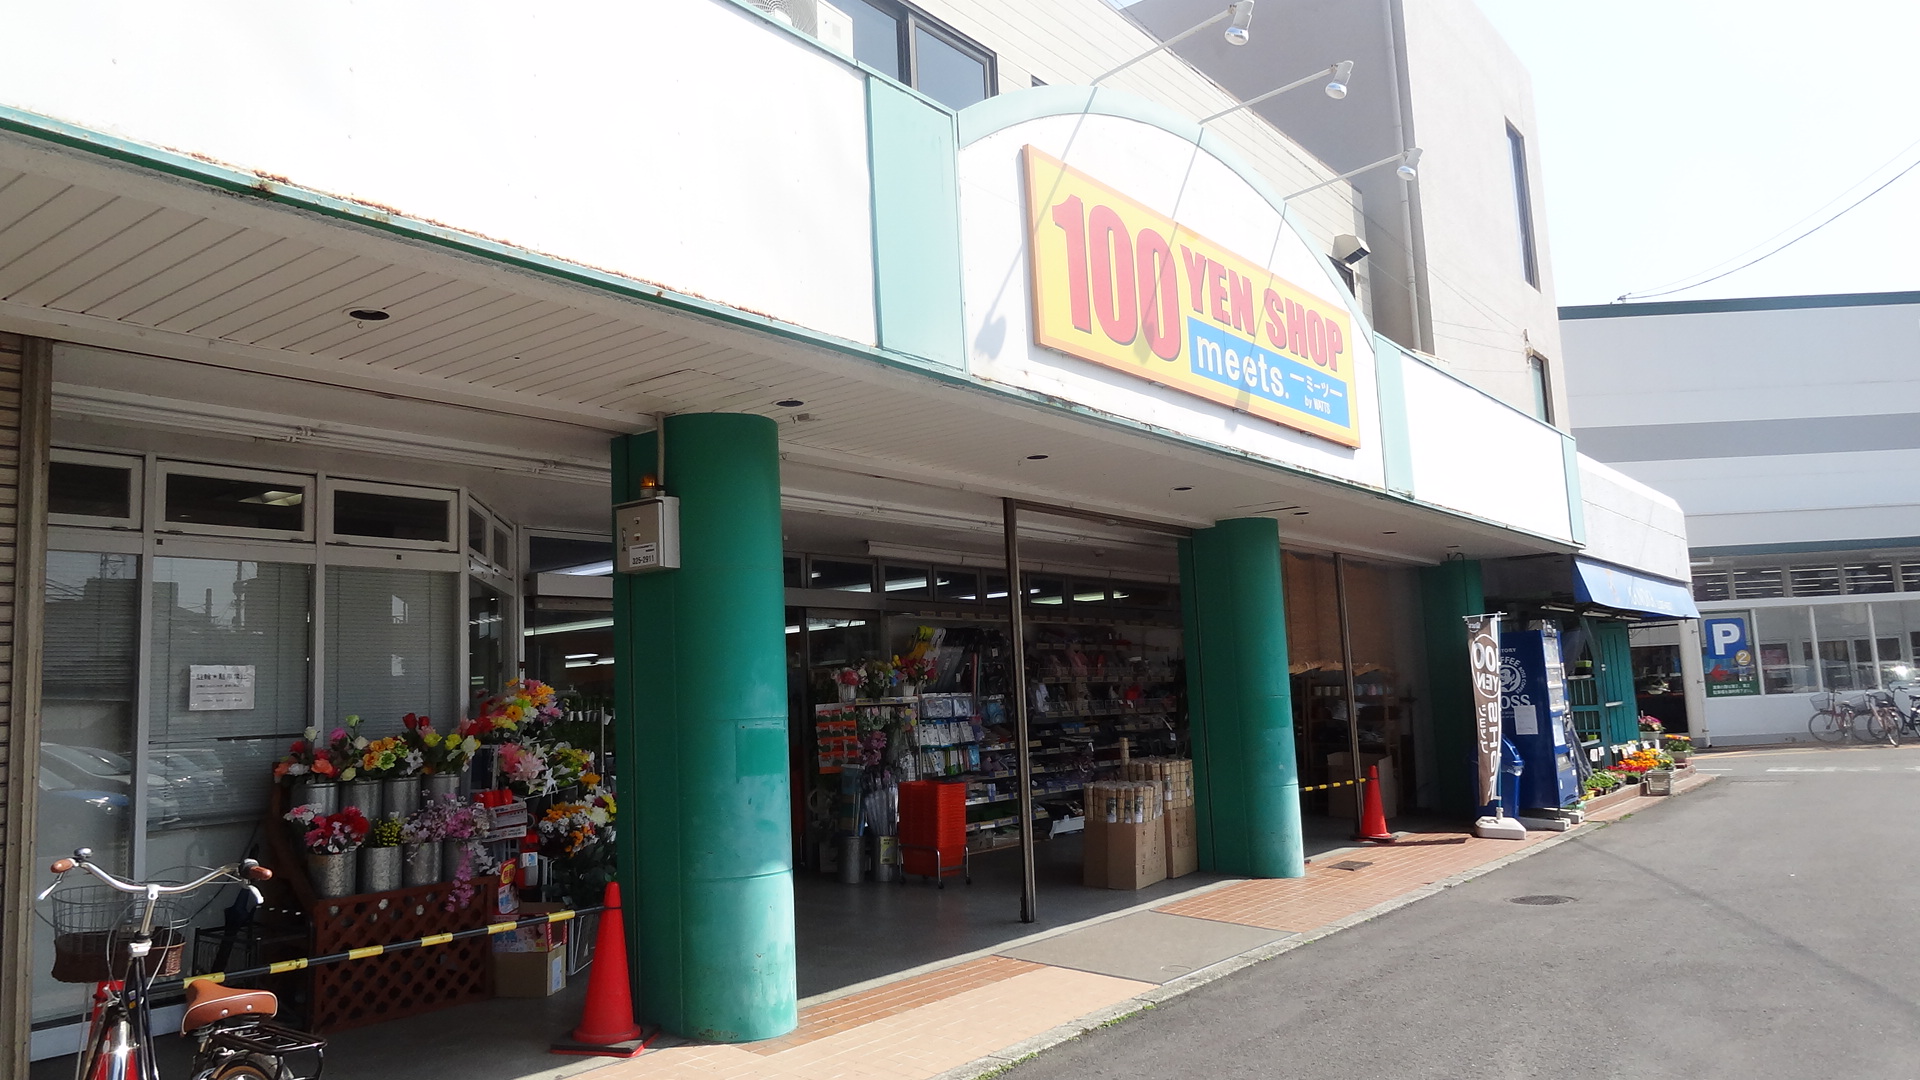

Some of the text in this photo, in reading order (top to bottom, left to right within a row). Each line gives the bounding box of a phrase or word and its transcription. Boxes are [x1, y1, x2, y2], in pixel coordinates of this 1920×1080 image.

[1052, 194, 1343, 372] 100 YEN SHOP
[1196, 335, 1290, 399] meets.
[1304, 395, 1312, 409] by
[1711, 623, 1740, 655] P
[1737, 652, 1748, 663] 2
[1500, 694, 1531, 709] OSS
